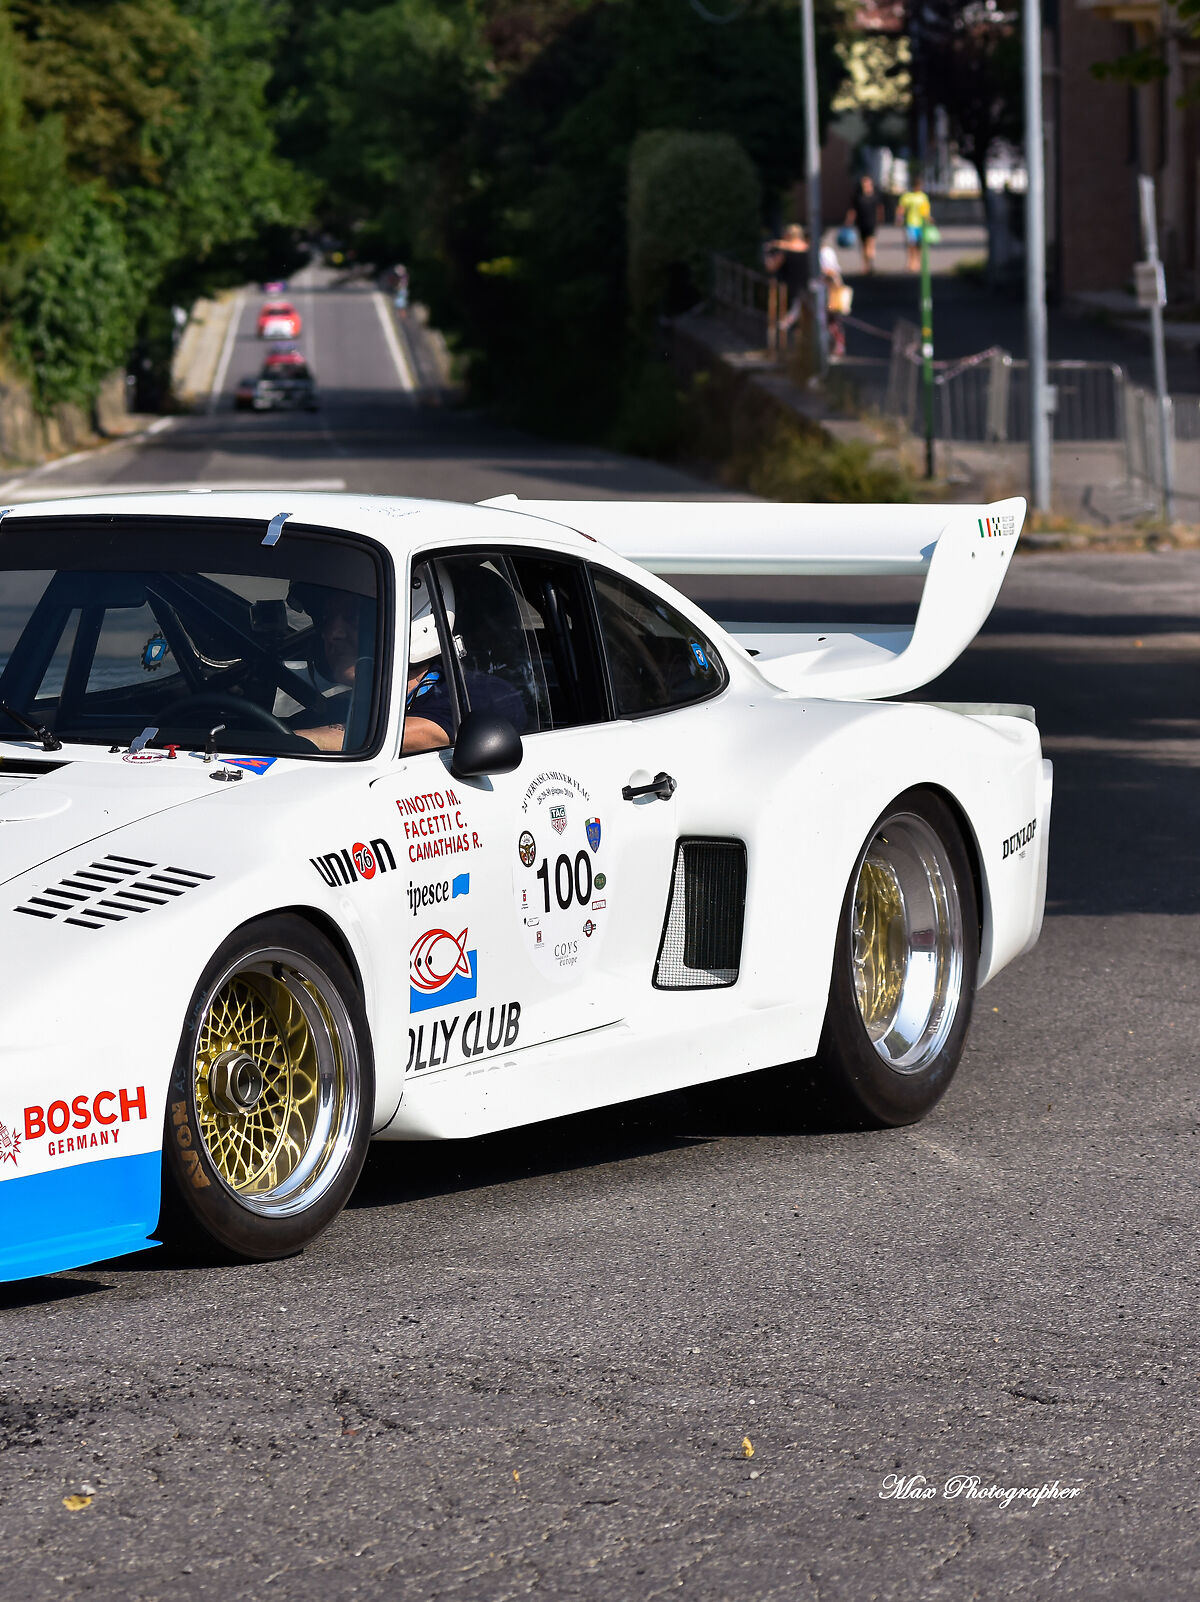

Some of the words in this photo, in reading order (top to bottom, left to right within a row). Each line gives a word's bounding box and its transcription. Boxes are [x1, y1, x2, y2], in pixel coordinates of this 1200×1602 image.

[396, 791, 445, 816] FINOTTO
[445, 789, 461, 807] M.
[551, 808, 566, 818] TAG
[404, 813, 452, 839] FACETTI
[455, 811, 467, 829] C.
[1002, 818, 1037, 860] DUNLOP
[355, 847, 373, 874] 76
[408, 833, 470, 863] CAMATHIAS
[472, 831, 483, 849] R.
[537, 850, 592, 913] 100
[407, 881, 450, 916] ipesce
[554, 940, 578, 957] COYS
[461, 1001, 521, 1058] CLUB
[23, 1085, 148, 1141] BOSCH
[48, 1128, 120, 1156] GERMANY
[171, 1100, 211, 1189] AVON
